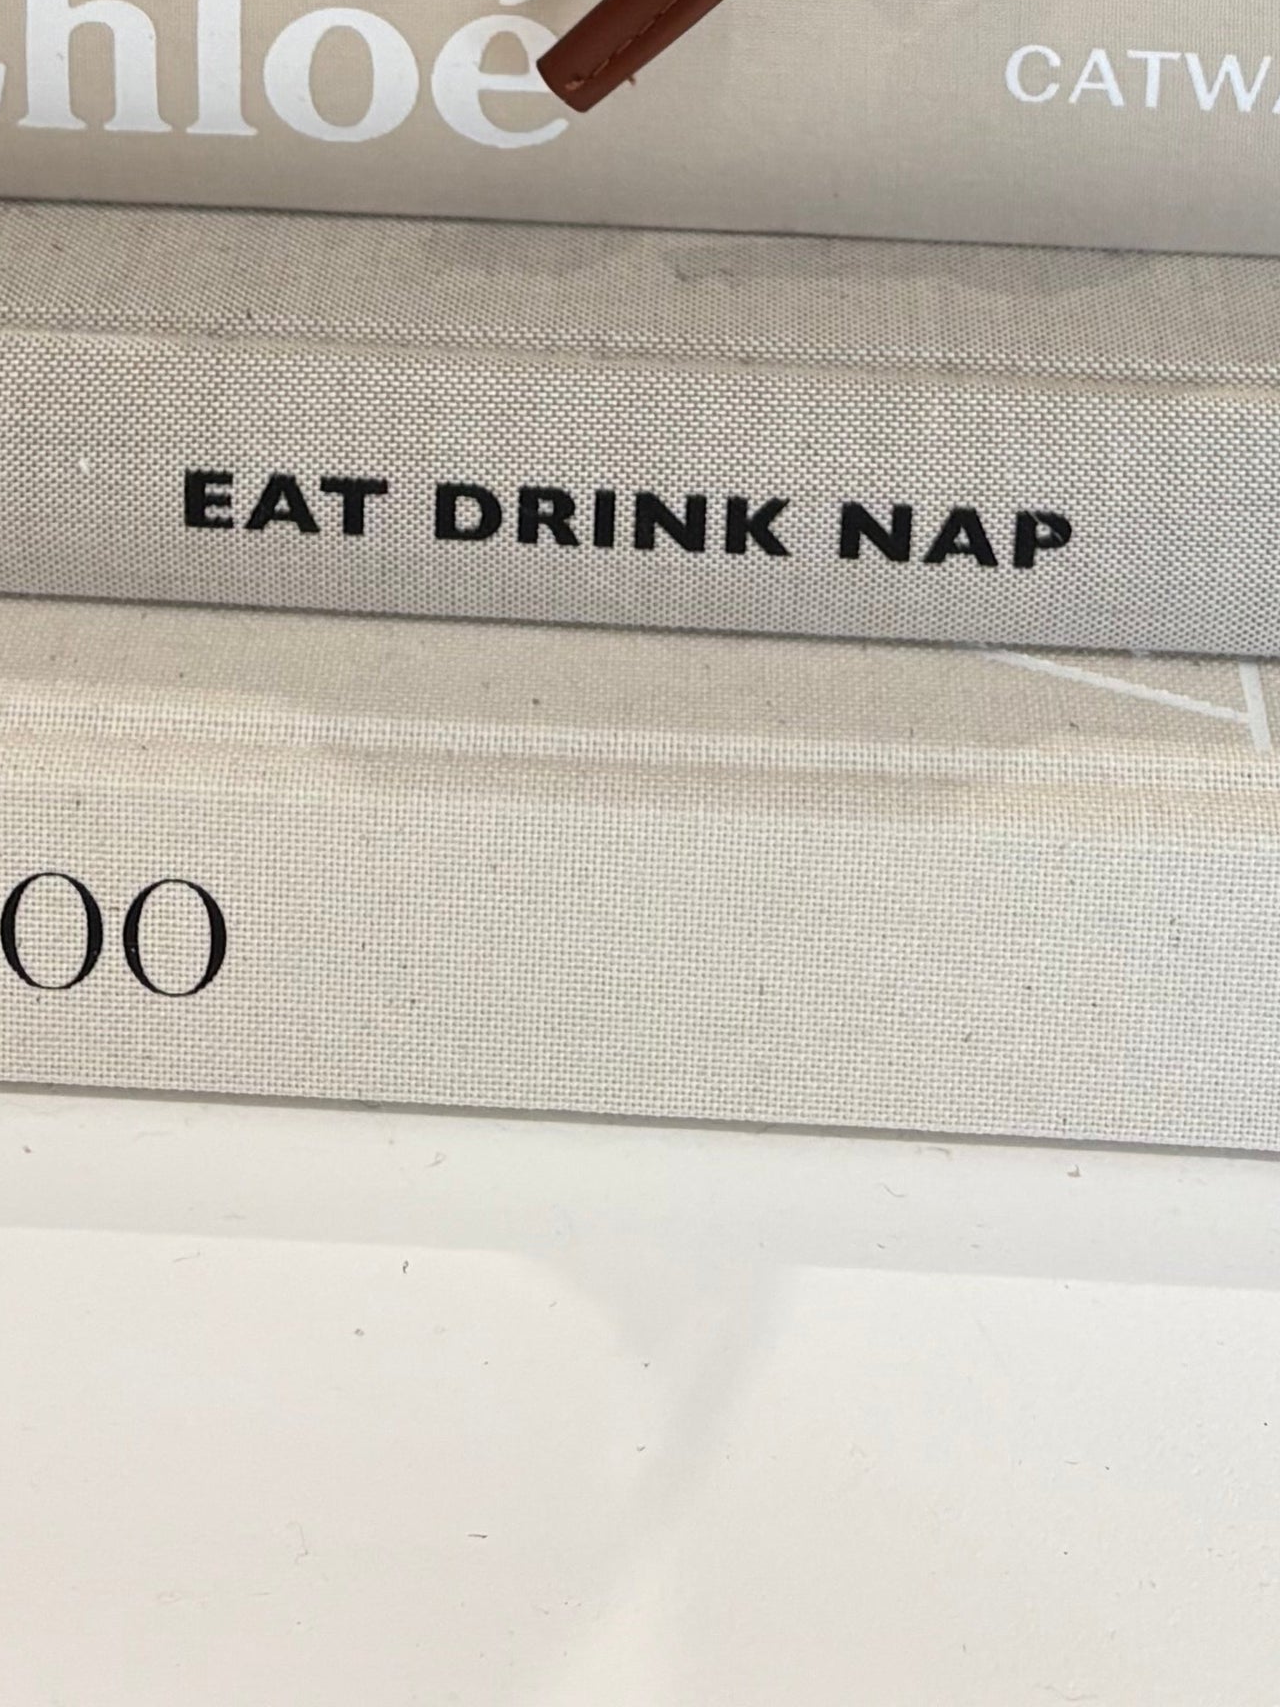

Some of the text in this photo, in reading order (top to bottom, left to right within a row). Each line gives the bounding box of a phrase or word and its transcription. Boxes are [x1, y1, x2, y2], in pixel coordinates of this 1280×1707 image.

[183, 469, 1073, 570] EAT DRINK NAP
